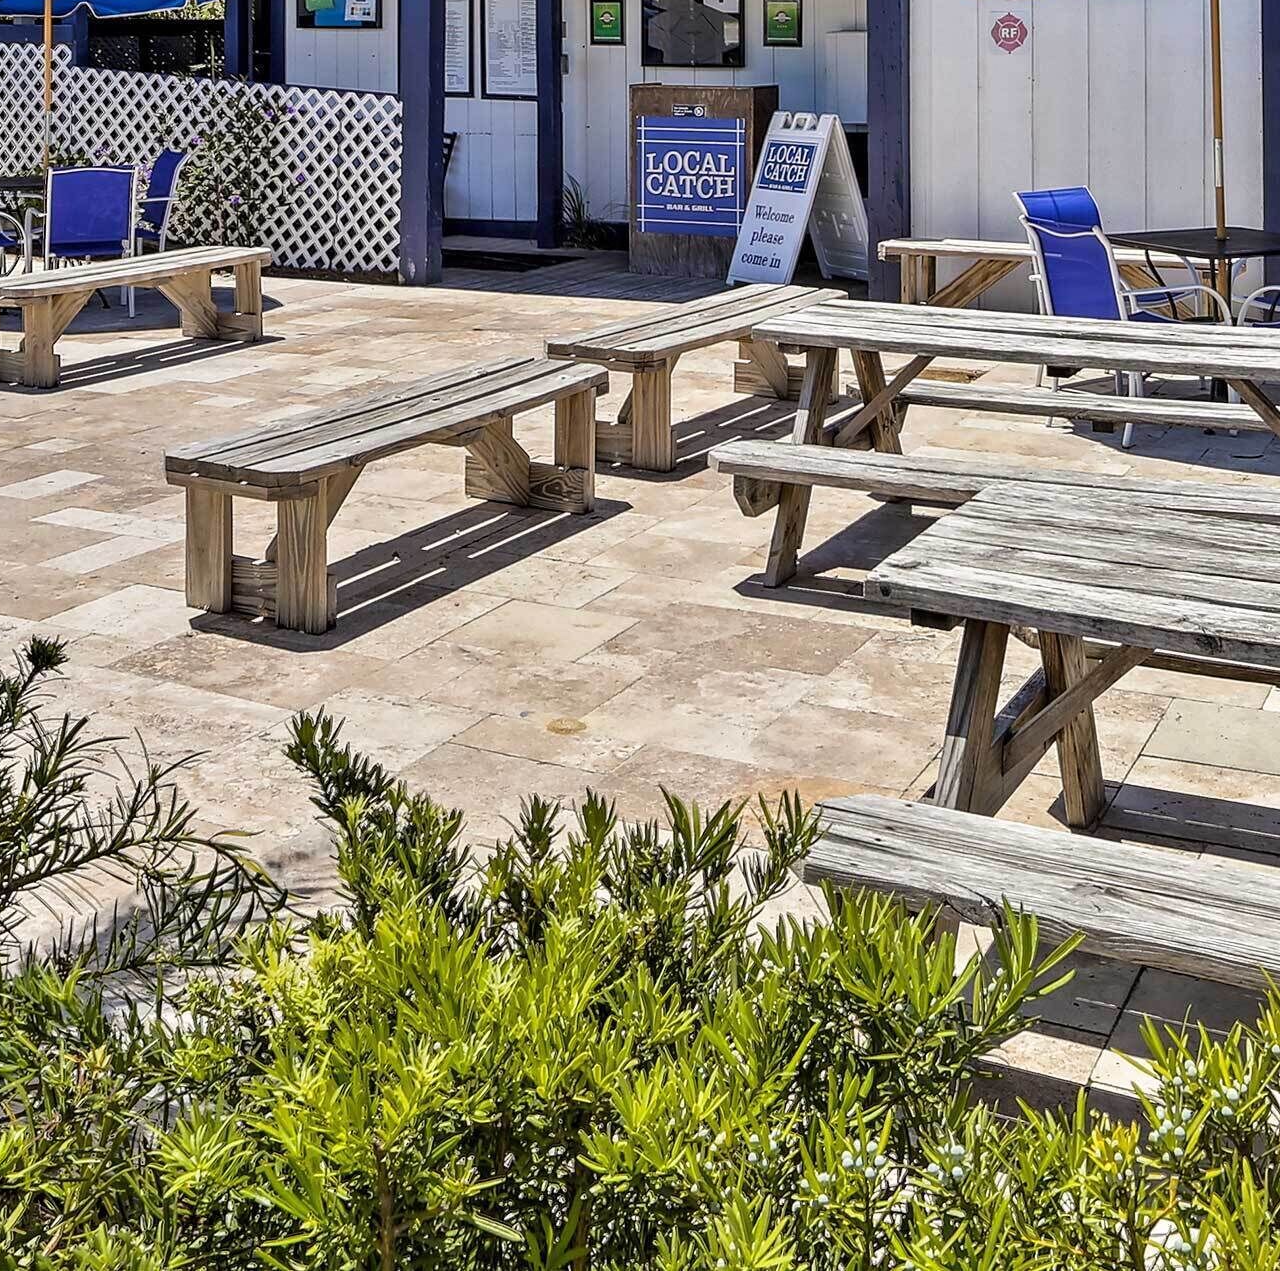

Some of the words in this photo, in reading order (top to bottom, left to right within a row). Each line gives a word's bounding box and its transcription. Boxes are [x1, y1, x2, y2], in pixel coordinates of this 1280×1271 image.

[1001, 28, 1018, 38] RF
[646, 151, 735, 176] LOCAL
[767, 145, 810, 165] LOCAL
[764, 162, 808, 183] CATCH
[646, 173, 735, 199] CATCH
[755, 205, 795, 224] Welcome
[750, 226, 784, 246] please
[741, 253, 768, 267] come
[769, 252, 781, 268] in
